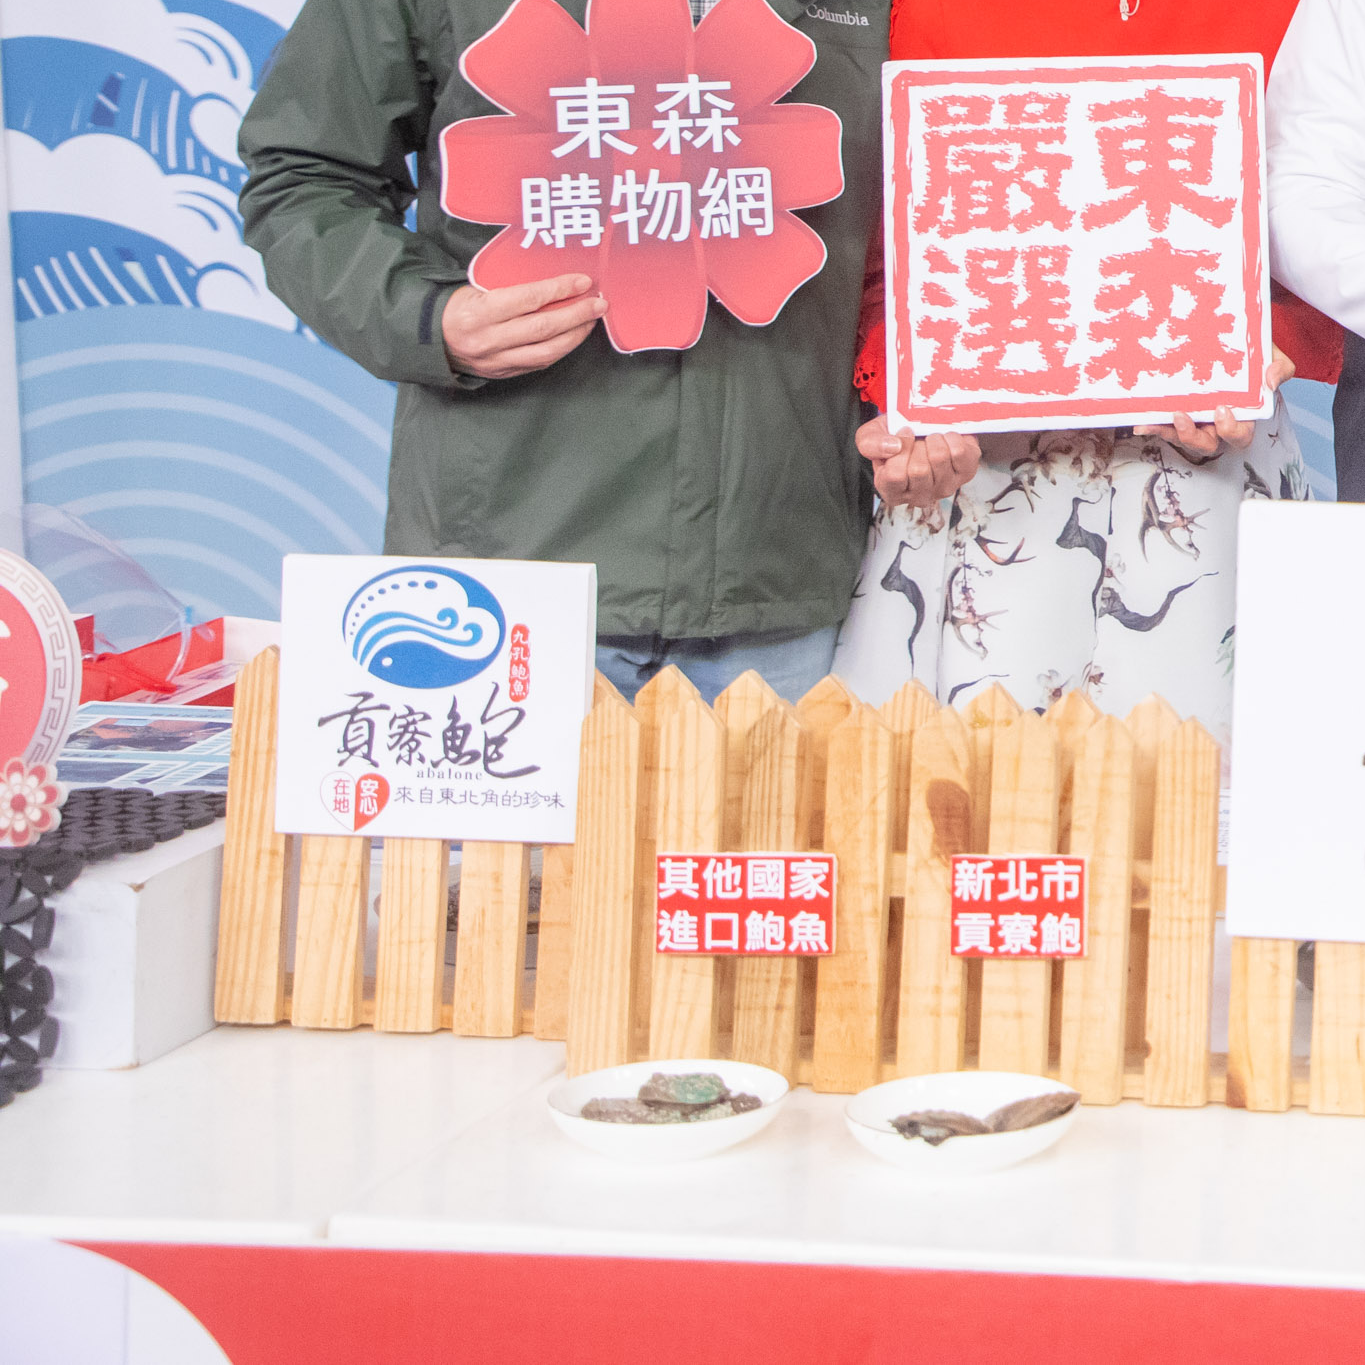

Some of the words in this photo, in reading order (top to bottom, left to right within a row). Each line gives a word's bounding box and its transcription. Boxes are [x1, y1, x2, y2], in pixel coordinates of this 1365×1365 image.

[806, 3, 869, 25] Columbia
[549, 73, 742, 160] 東森
[519, 166, 775, 250] 購物網
[911, 91, 1081, 405] 嚴選
[1081, 85, 1246, 390] 東森
[510, 631, 529, 696] 九孔鮑魚
[317, 682, 541, 779] 貢寮鮑
[416, 767, 483, 781] abalone
[333, 778, 350, 814] 在地
[359, 778, 379, 815] 安心
[394, 786, 566, 809] 來自東北角的珍味
[658, 857, 830, 900] 其他國家
[954, 860, 1082, 902] 新北市
[658, 909, 830, 952] 進口鮑魚
[954, 914, 1082, 955] 貢寮鮑
